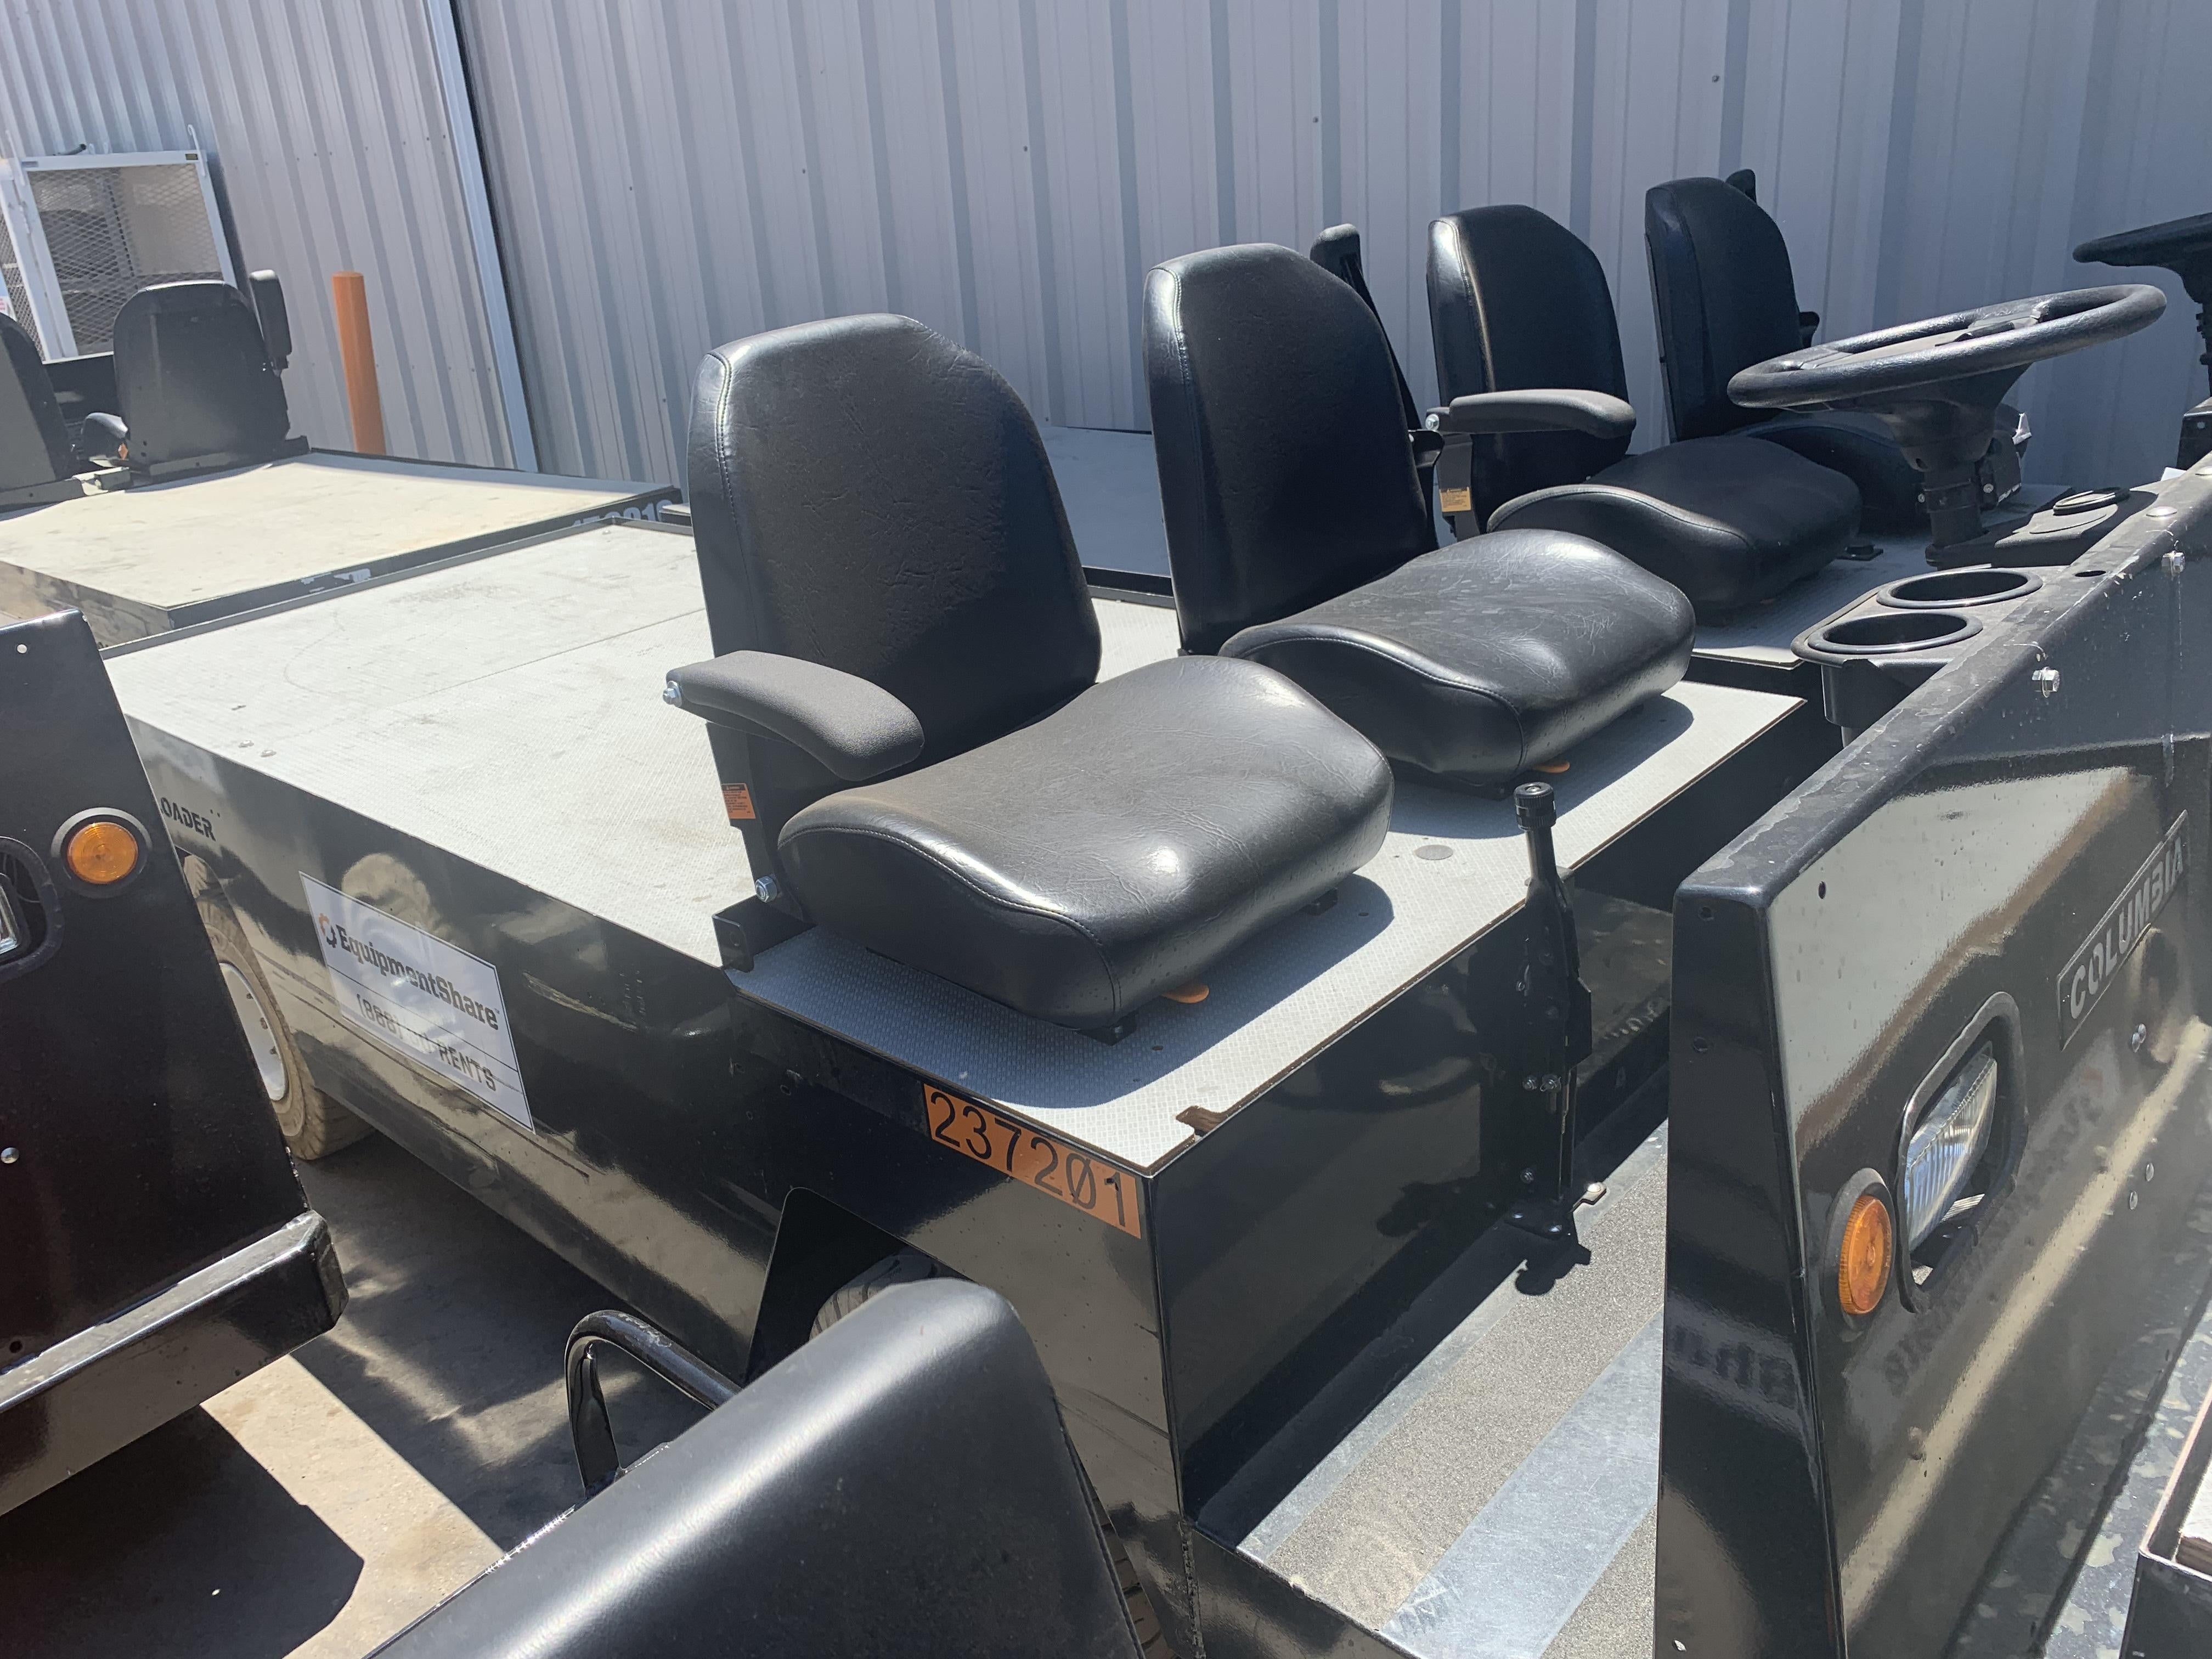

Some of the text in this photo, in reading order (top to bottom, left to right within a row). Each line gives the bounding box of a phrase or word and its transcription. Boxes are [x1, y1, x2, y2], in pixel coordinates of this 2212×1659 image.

[160, 797, 216, 842] OADER
[2070, 837, 2184, 1020] COLUMBIA
[930, 1092, 1126, 1228] 237201
